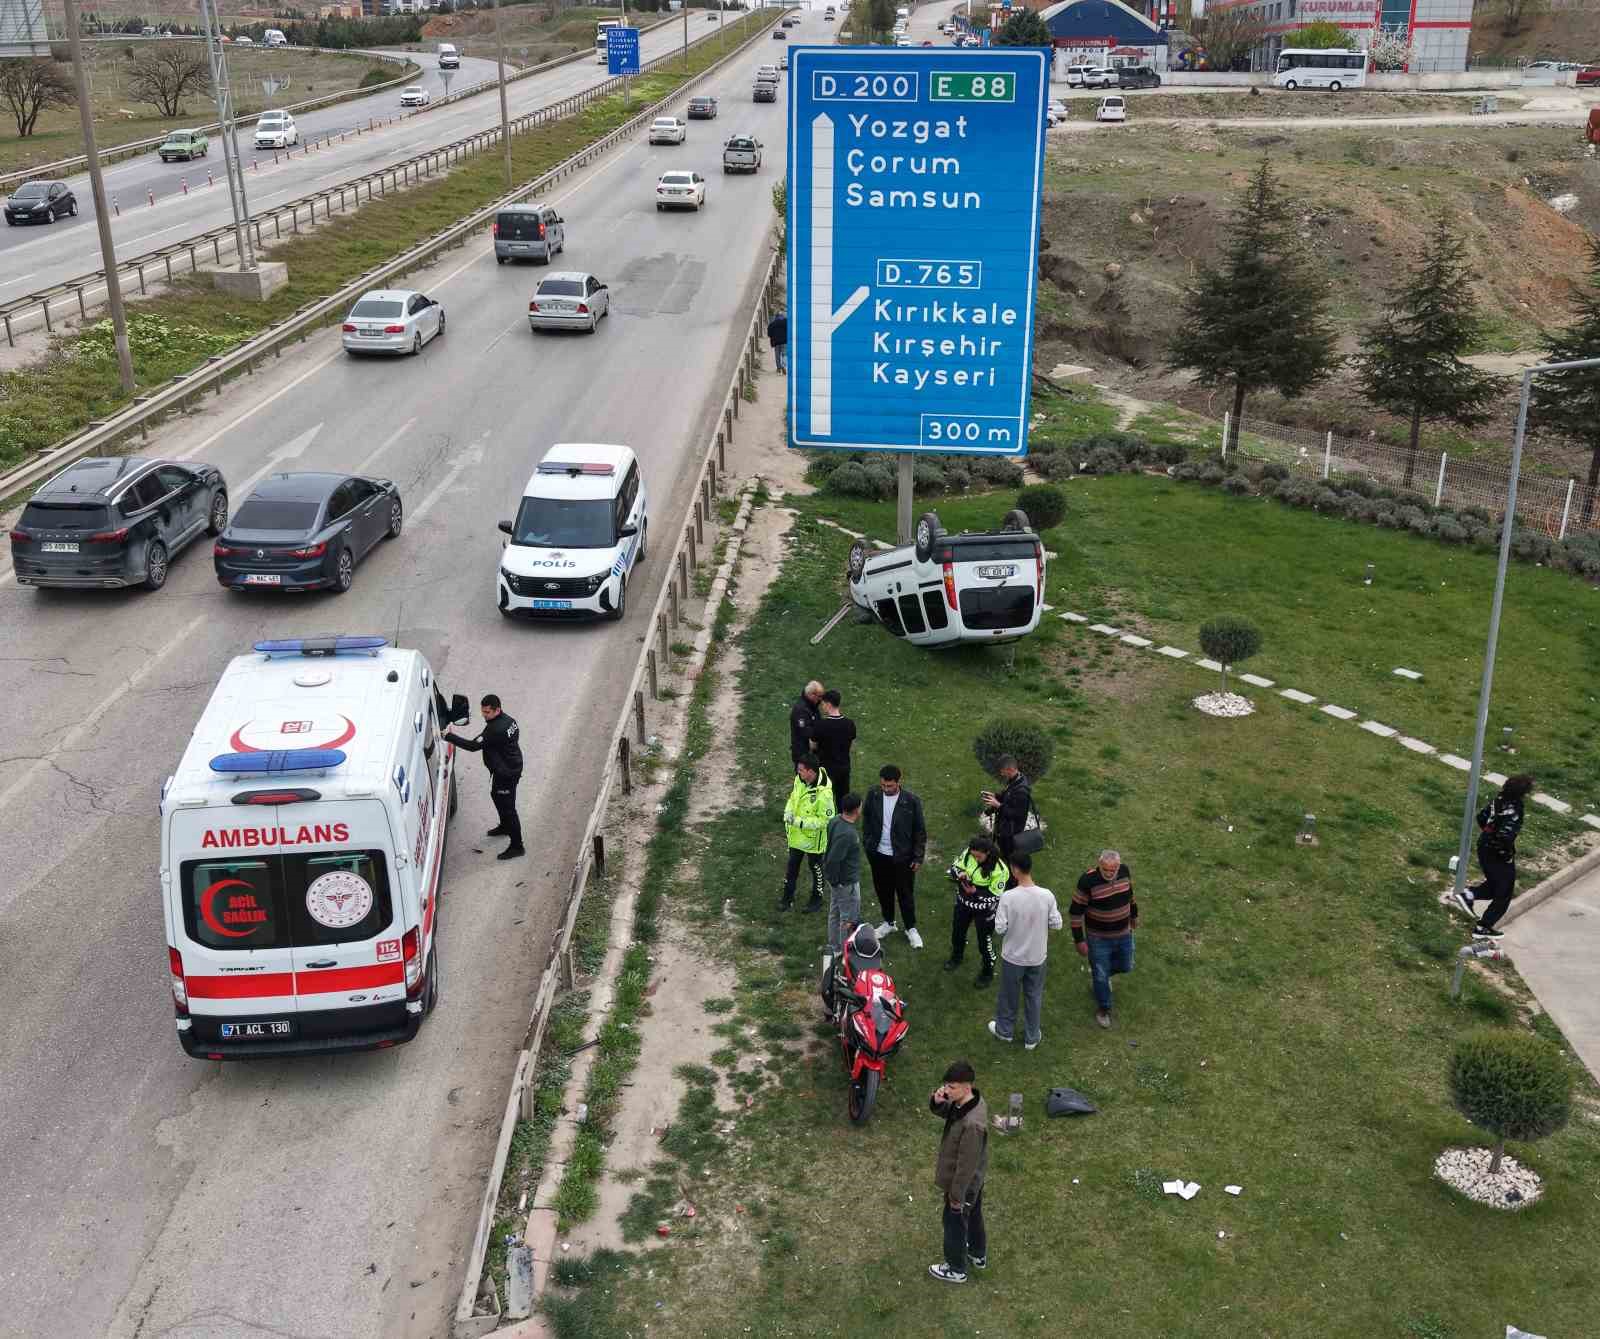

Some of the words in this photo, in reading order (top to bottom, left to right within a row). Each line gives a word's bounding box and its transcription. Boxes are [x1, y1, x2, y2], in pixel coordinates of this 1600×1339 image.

[848, 114, 968, 144] Yozgat
[846, 149, 961, 176] Çorum
[846, 183, 981, 209] Samsun
[874, 299, 1017, 325] Kırıkkale
[873, 333, 1002, 357] Kırşehir
[873, 363, 996, 390] Kayseri
[928, 422, 980, 441] 300
[988, 426, 1010, 441] m
[201, 823, 350, 848] AMBULANS
[379, 942, 399, 953] 112
[227, 1024, 241, 1035] 71
[246, 1024, 264, 1034] ACL
[271, 1023, 288, 1034] 130
